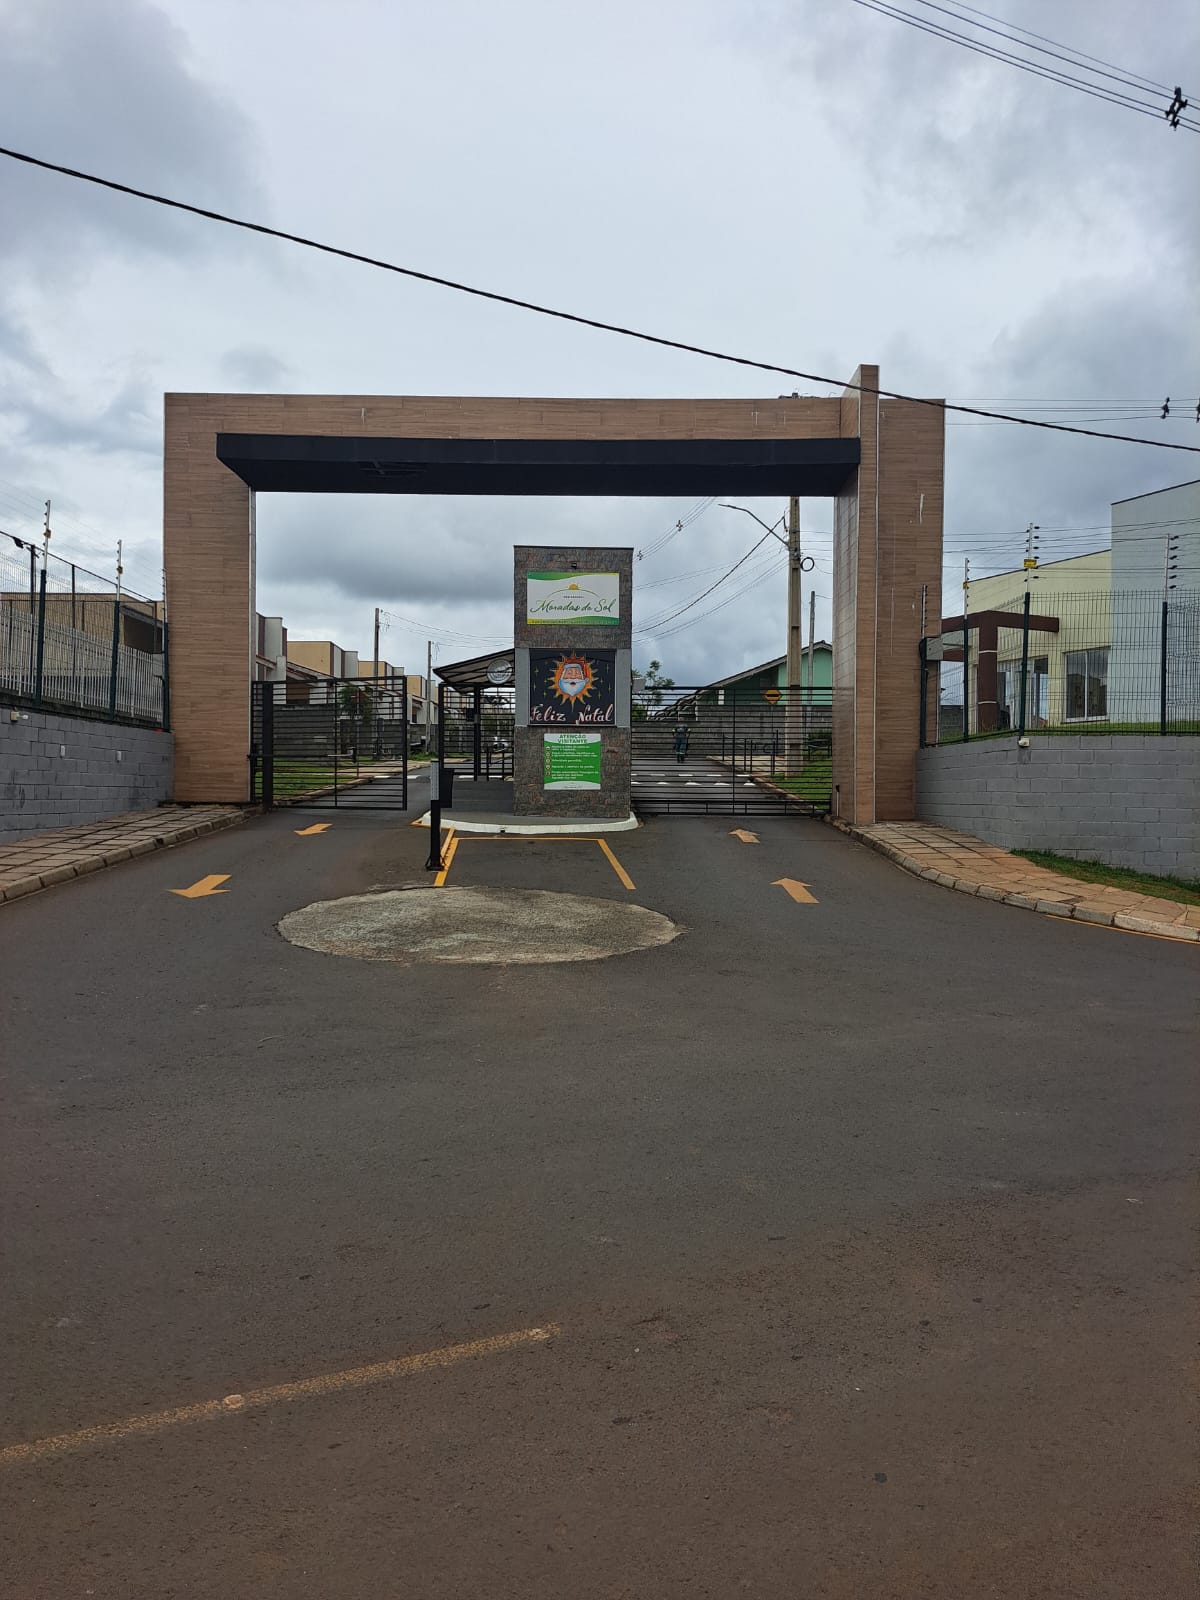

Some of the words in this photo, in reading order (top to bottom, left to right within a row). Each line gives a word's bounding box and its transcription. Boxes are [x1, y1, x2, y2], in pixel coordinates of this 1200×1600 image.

[530, 599, 580, 613] Moradas
[594, 598, 616, 613] Sol
[530, 703, 566, 722] Feliz
[576, 703, 614, 725] Natal
